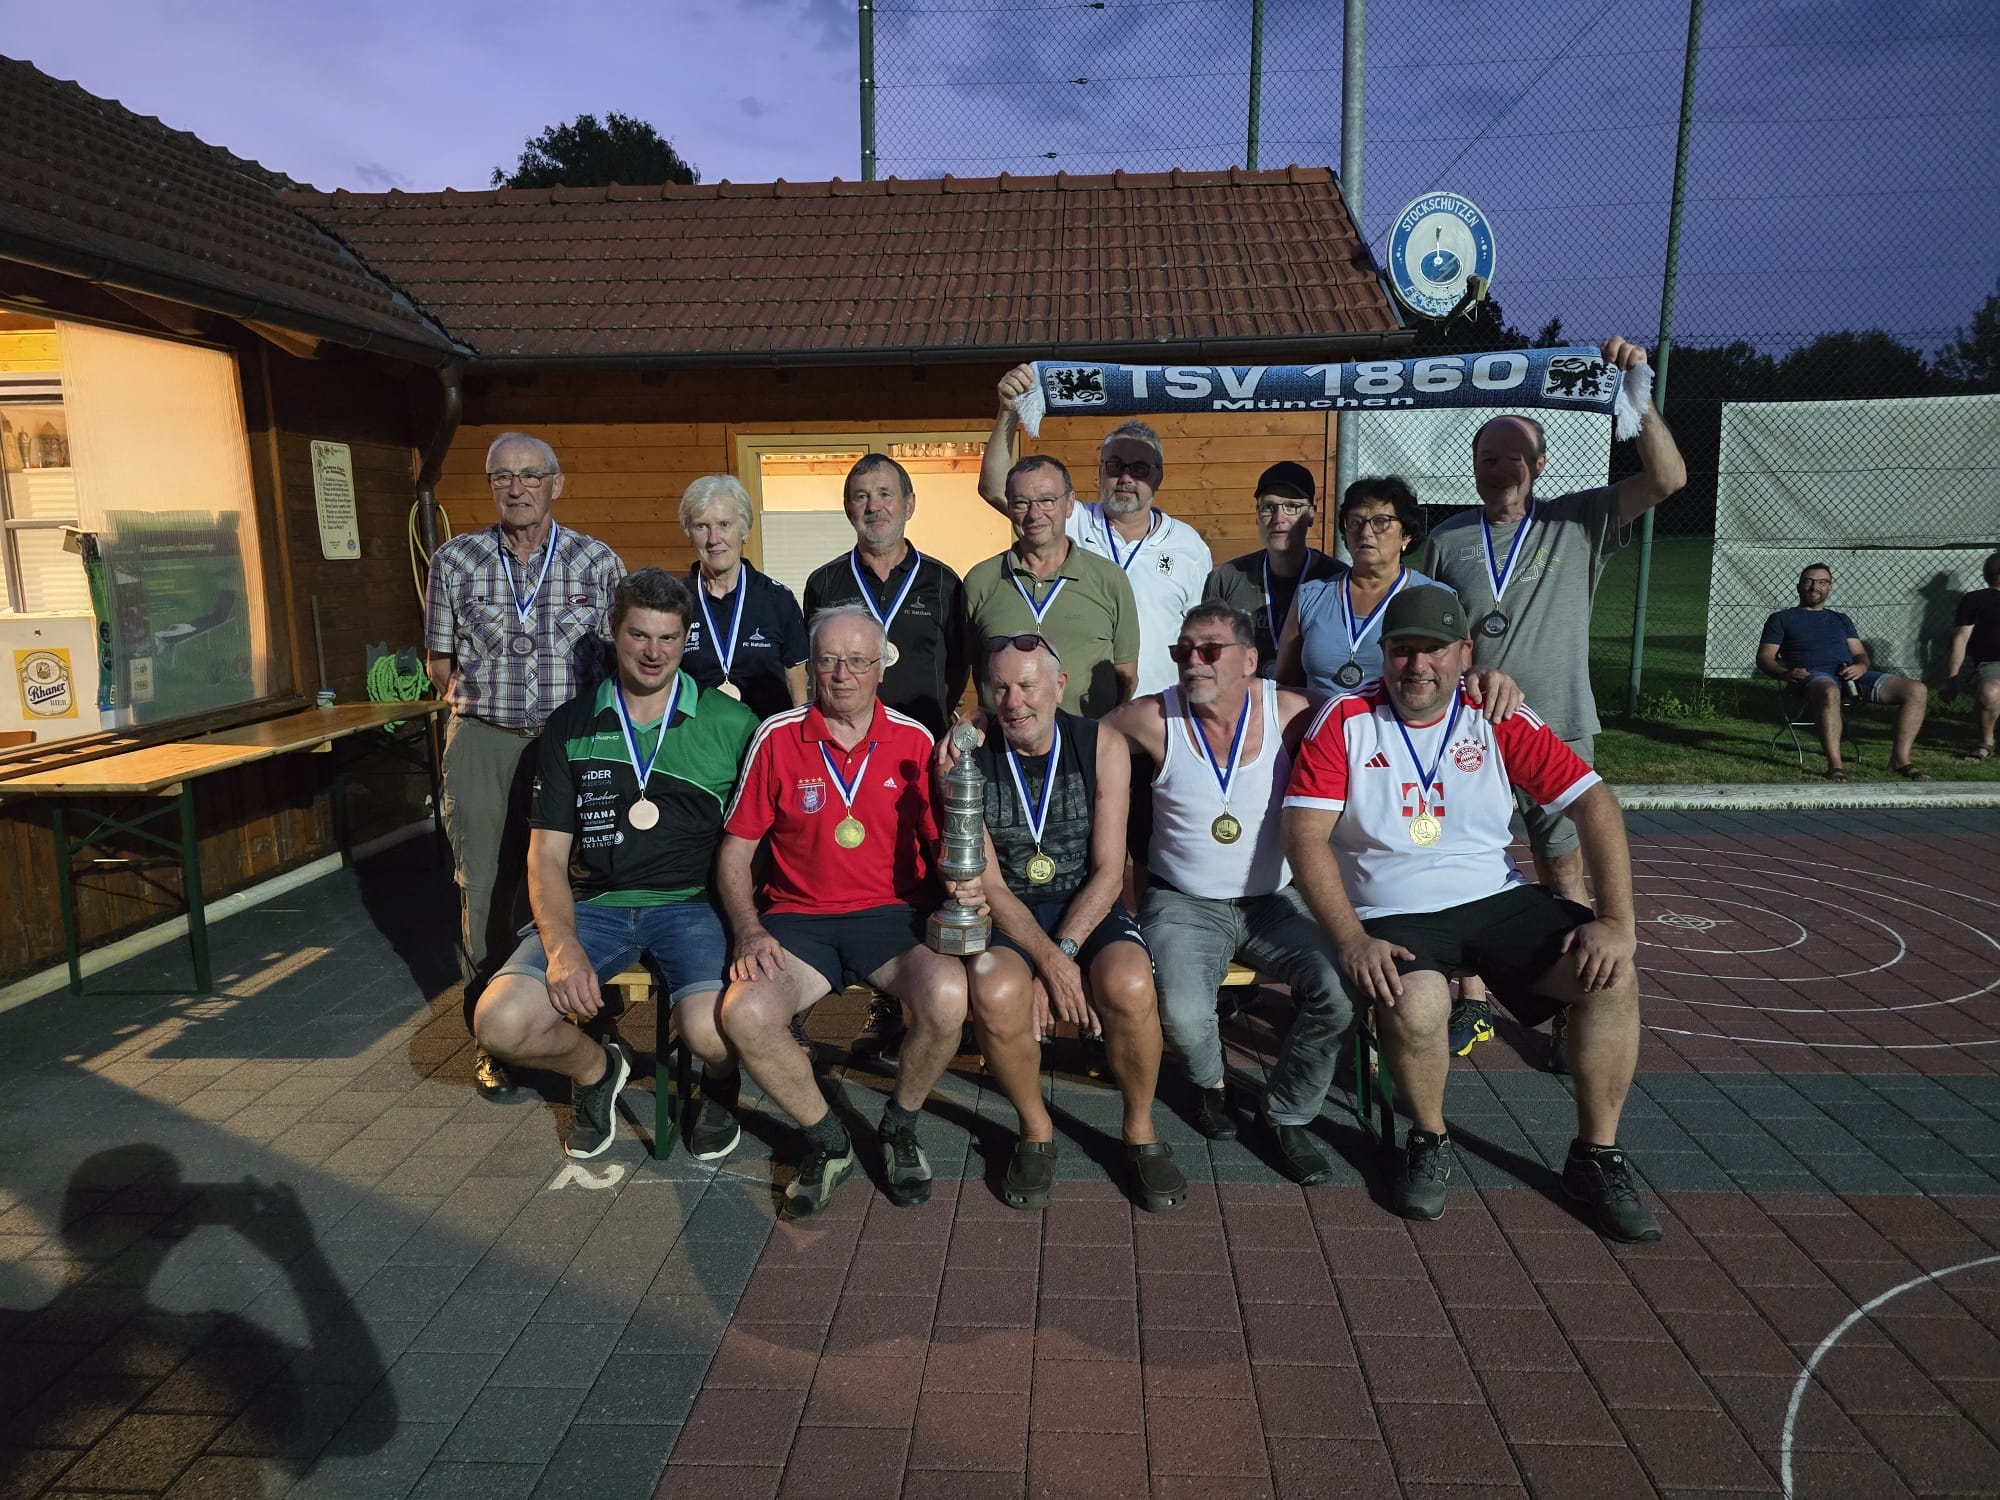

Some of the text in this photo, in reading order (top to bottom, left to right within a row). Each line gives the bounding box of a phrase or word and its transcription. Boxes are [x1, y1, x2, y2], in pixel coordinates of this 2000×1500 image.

[1118, 352, 1530, 399] TSV 1860
[1603, 366, 1618, 395] 1860
[1212, 396, 1415, 411] München
[27, 683, 65, 702] Rhaner
